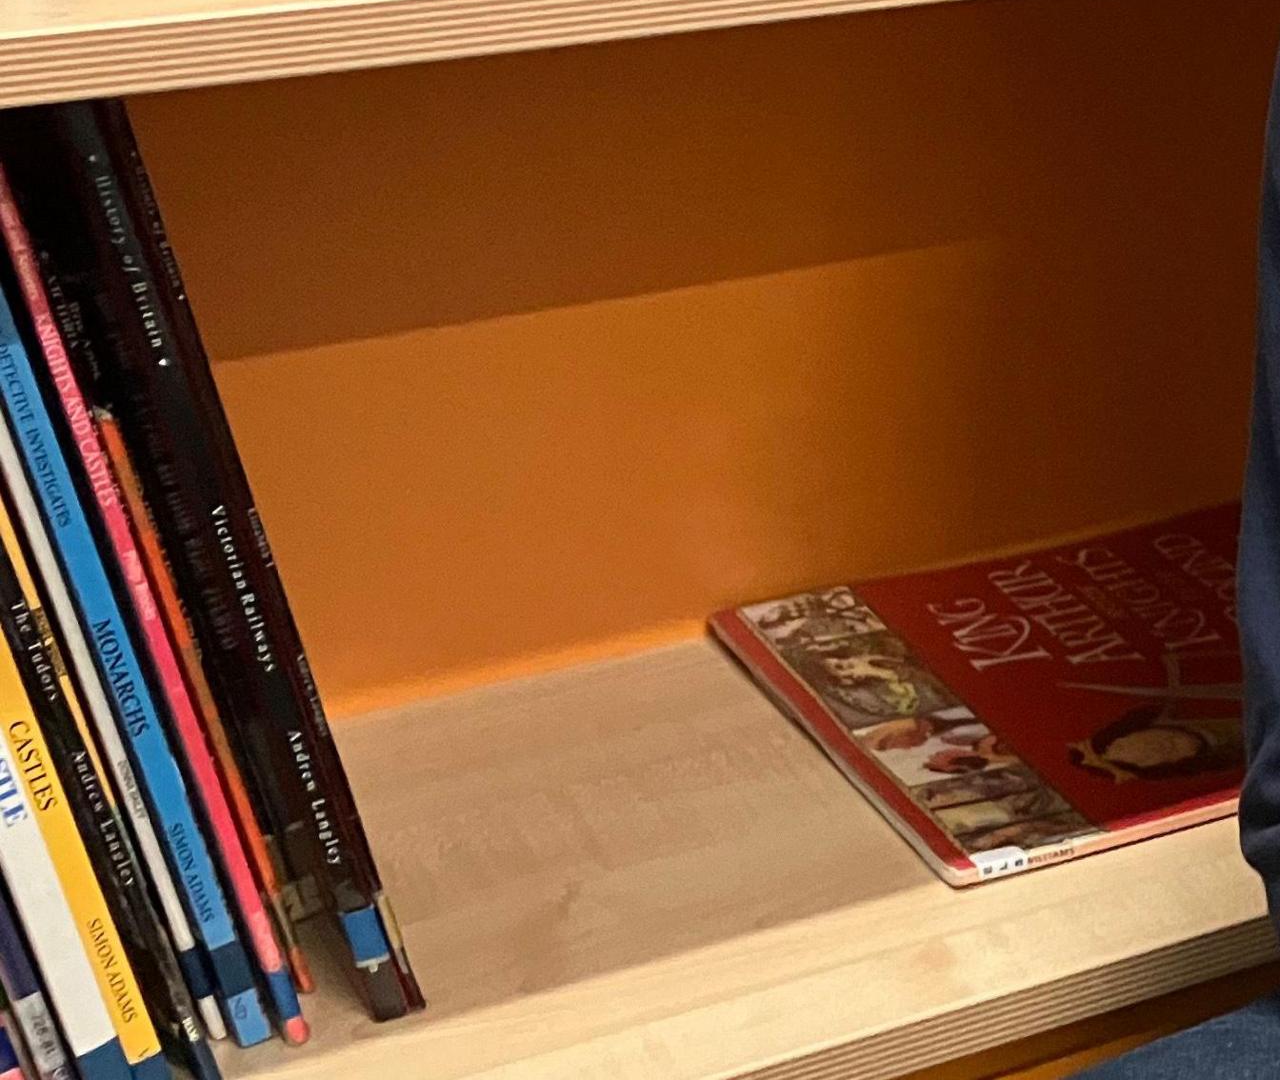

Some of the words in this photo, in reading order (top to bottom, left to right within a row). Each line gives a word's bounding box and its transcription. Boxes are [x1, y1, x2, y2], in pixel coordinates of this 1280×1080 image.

[88, 173, 132, 247] History
[117, 252, 142, 278] of
[129, 279, 167, 348] Britain
[31, 311, 77, 393] KNIGHTS
[63, 393, 93, 436] AND
[78, 435, 119, 507] CASTLES
[208, 503, 252, 590] Victorian
[234, 590, 281, 674] Railways
[925, 596, 1054, 673] KING
[986, 558, 1144, 667] ARTHUR
[9, 598, 35, 634] The
[25, 640, 63, 703] Tudors
[91, 618, 150, 737] MONARCHS
[5, 718, 59, 813] CASTLES
[70, 748, 107, 812] Andrew
[98, 818, 138, 888] Langley
[285, 727, 322, 793] Andrew
[306, 796, 347, 867] Langley
[166, 821, 197, 872] SIMON
[185, 871, 215, 923] ADAMS
[83, 916, 118, 971] SIMON
[105, 969, 138, 1024] ADAMS
